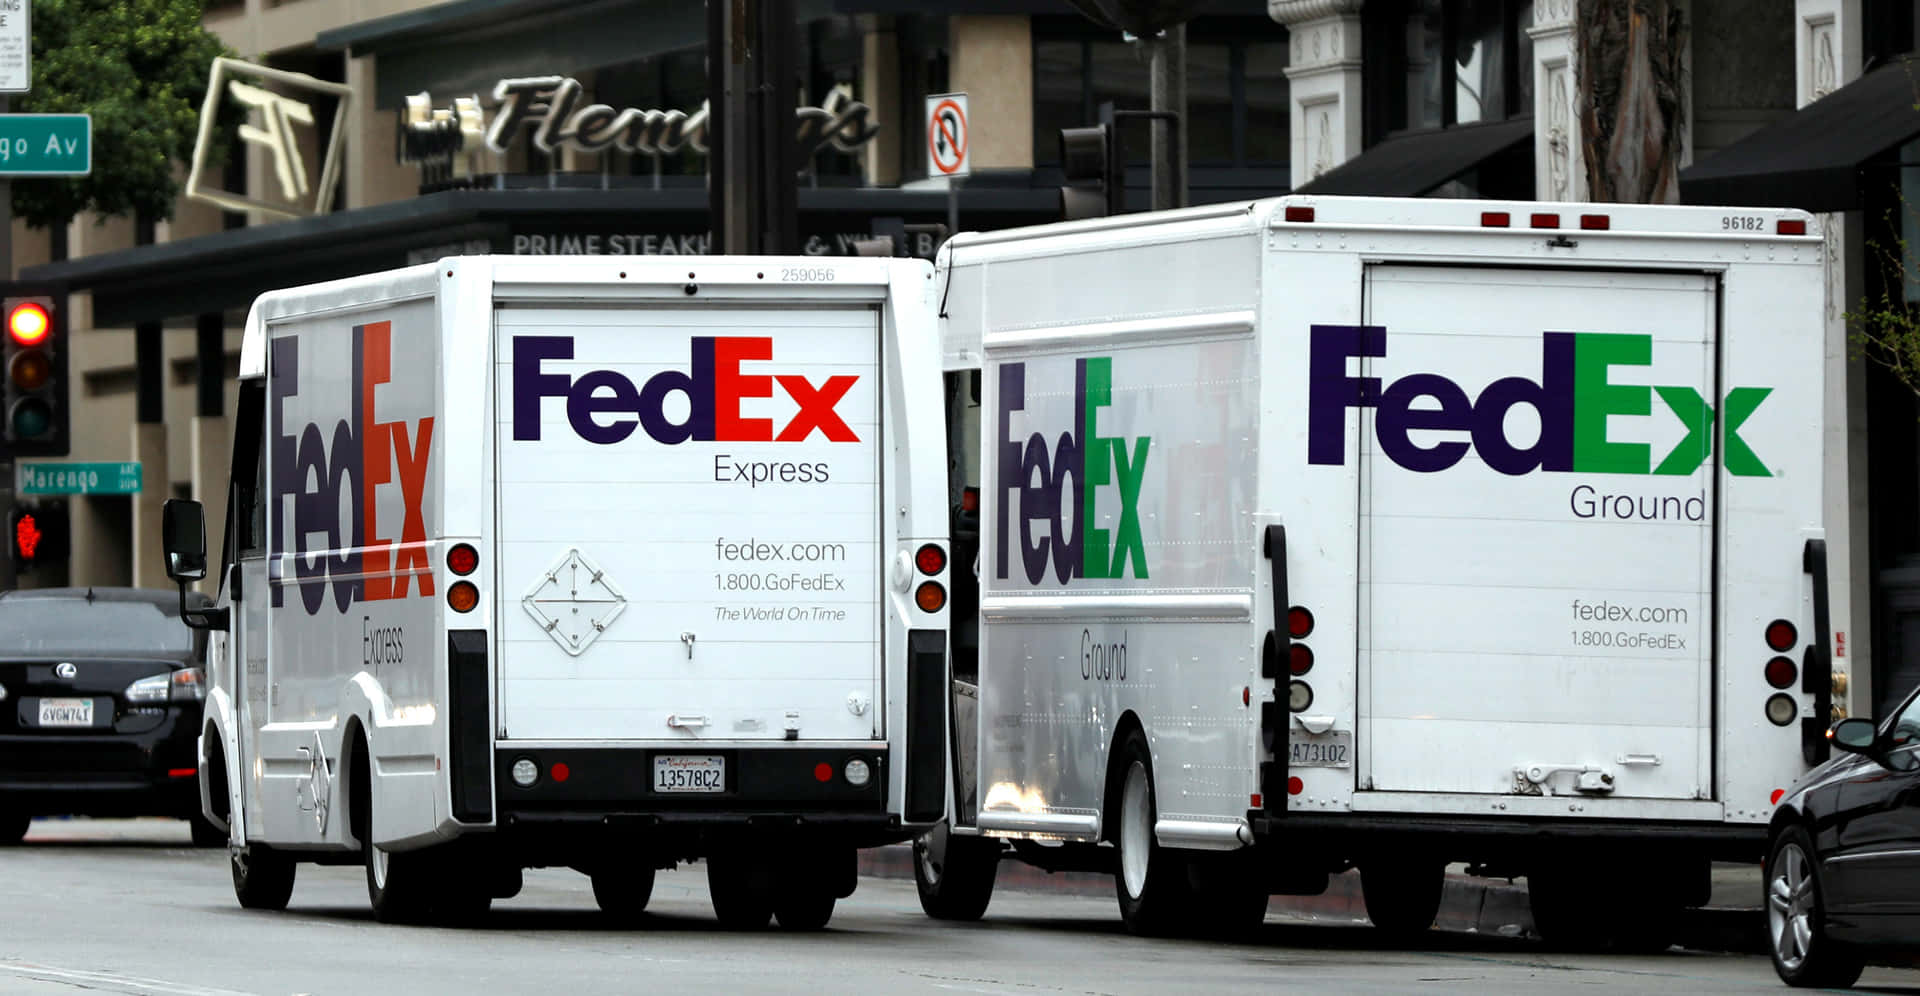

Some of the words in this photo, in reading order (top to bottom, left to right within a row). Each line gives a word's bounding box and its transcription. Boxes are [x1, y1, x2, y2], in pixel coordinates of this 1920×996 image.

[45, 133, 77, 155] Av
[1722, 217, 1764, 230] 96182
[514, 235, 600, 255] PRIME
[608, 234, 711, 255] STEAKH
[782, 269, 835, 281] 259056
[513, 336, 861, 445] FedEx
[1308, 324, 1775, 478] FedEx
[271, 320, 435, 615] FedEx
[714, 455, 829, 488] Express
[997, 357, 1151, 586] FedEx
[23, 466, 98, 494] Marengo
[1571, 485, 1706, 522] Ground
[715, 537, 845, 561] fedex.com
[715, 573, 845, 591] 1.800.GoFedEx
[715, 607, 740, 621] The
[743, 607, 784, 621] World
[787, 607, 808, 621] On
[812, 607, 846, 621] Time
[1572, 599, 1688, 624] fedex.com
[363, 615, 404, 677] Express
[1572, 630, 1686, 649] 1.800.GoFedEx
[1081, 628, 1128, 680] Ground
[1289, 744, 1347, 762] A73102
[659, 770, 720, 787] 13578C2
